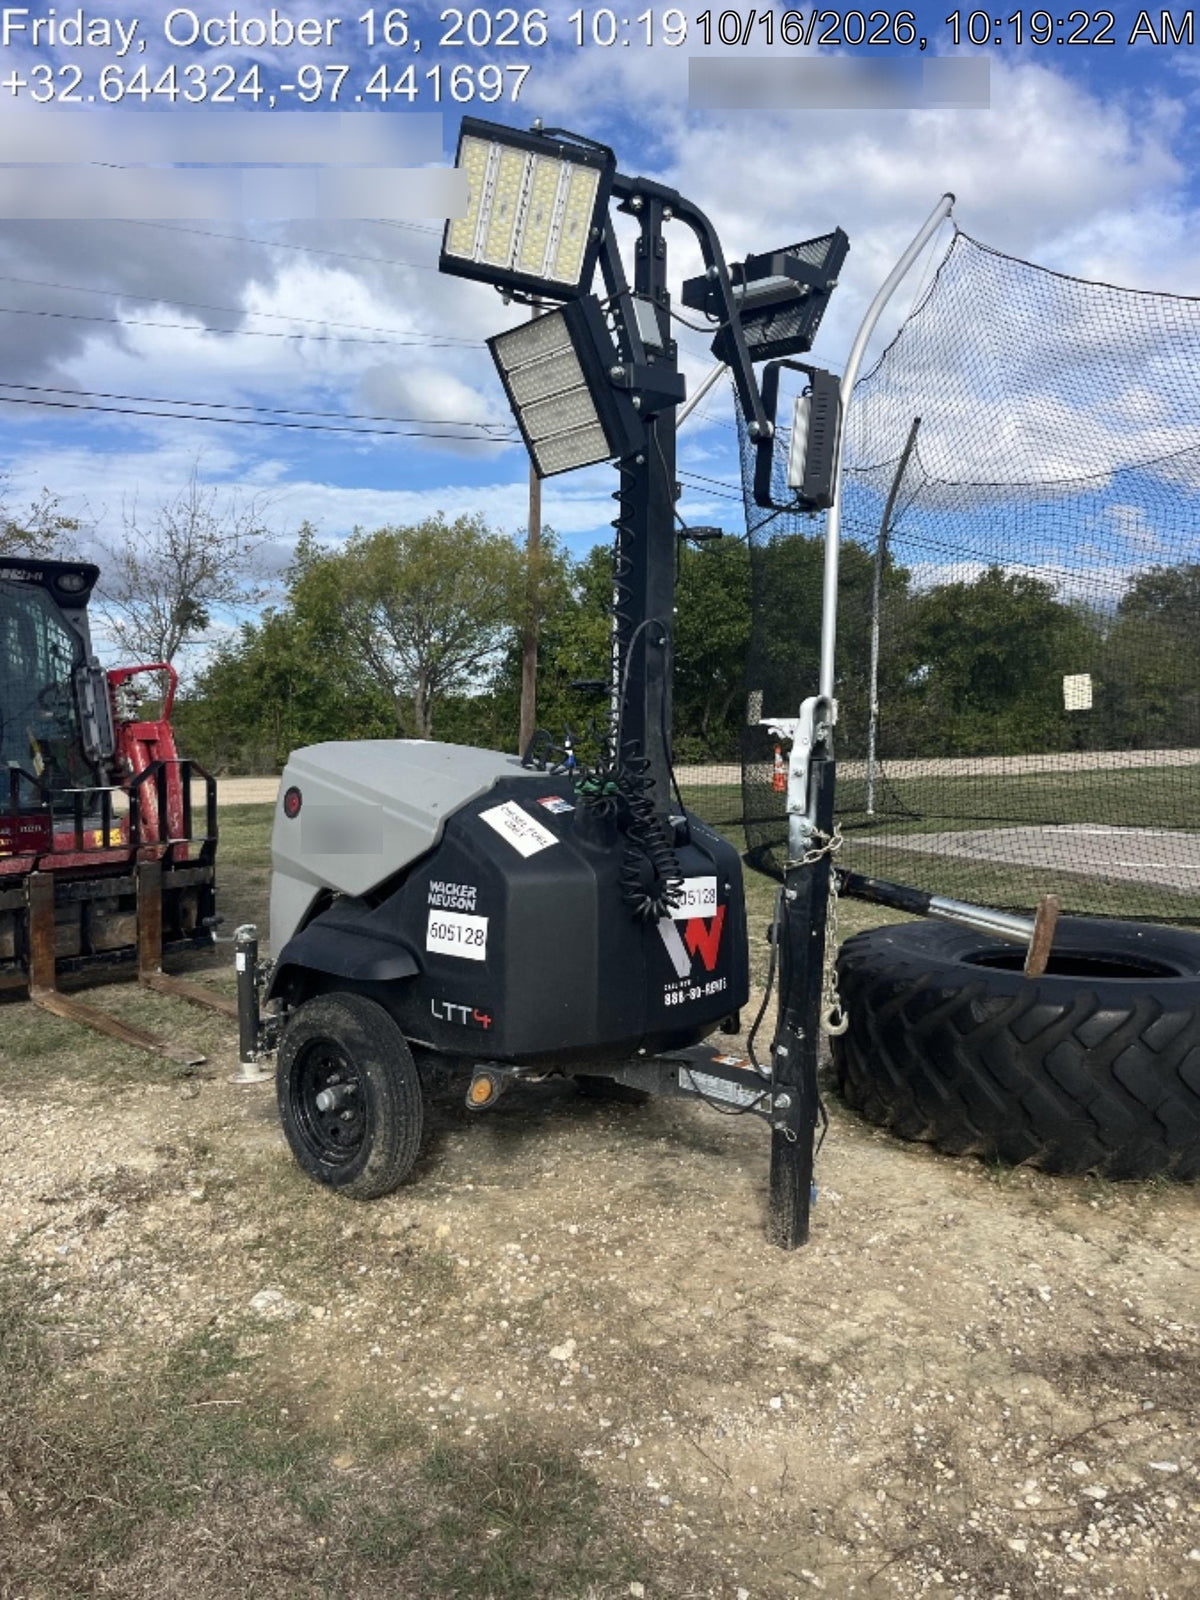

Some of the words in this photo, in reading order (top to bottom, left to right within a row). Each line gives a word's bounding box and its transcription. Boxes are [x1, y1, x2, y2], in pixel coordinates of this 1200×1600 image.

[429, 880, 477, 899] WACKER
[427, 892, 477, 911] NEUSON
[429, 922, 485, 947] 605128
[431, 998, 492, 1029] LTT4
